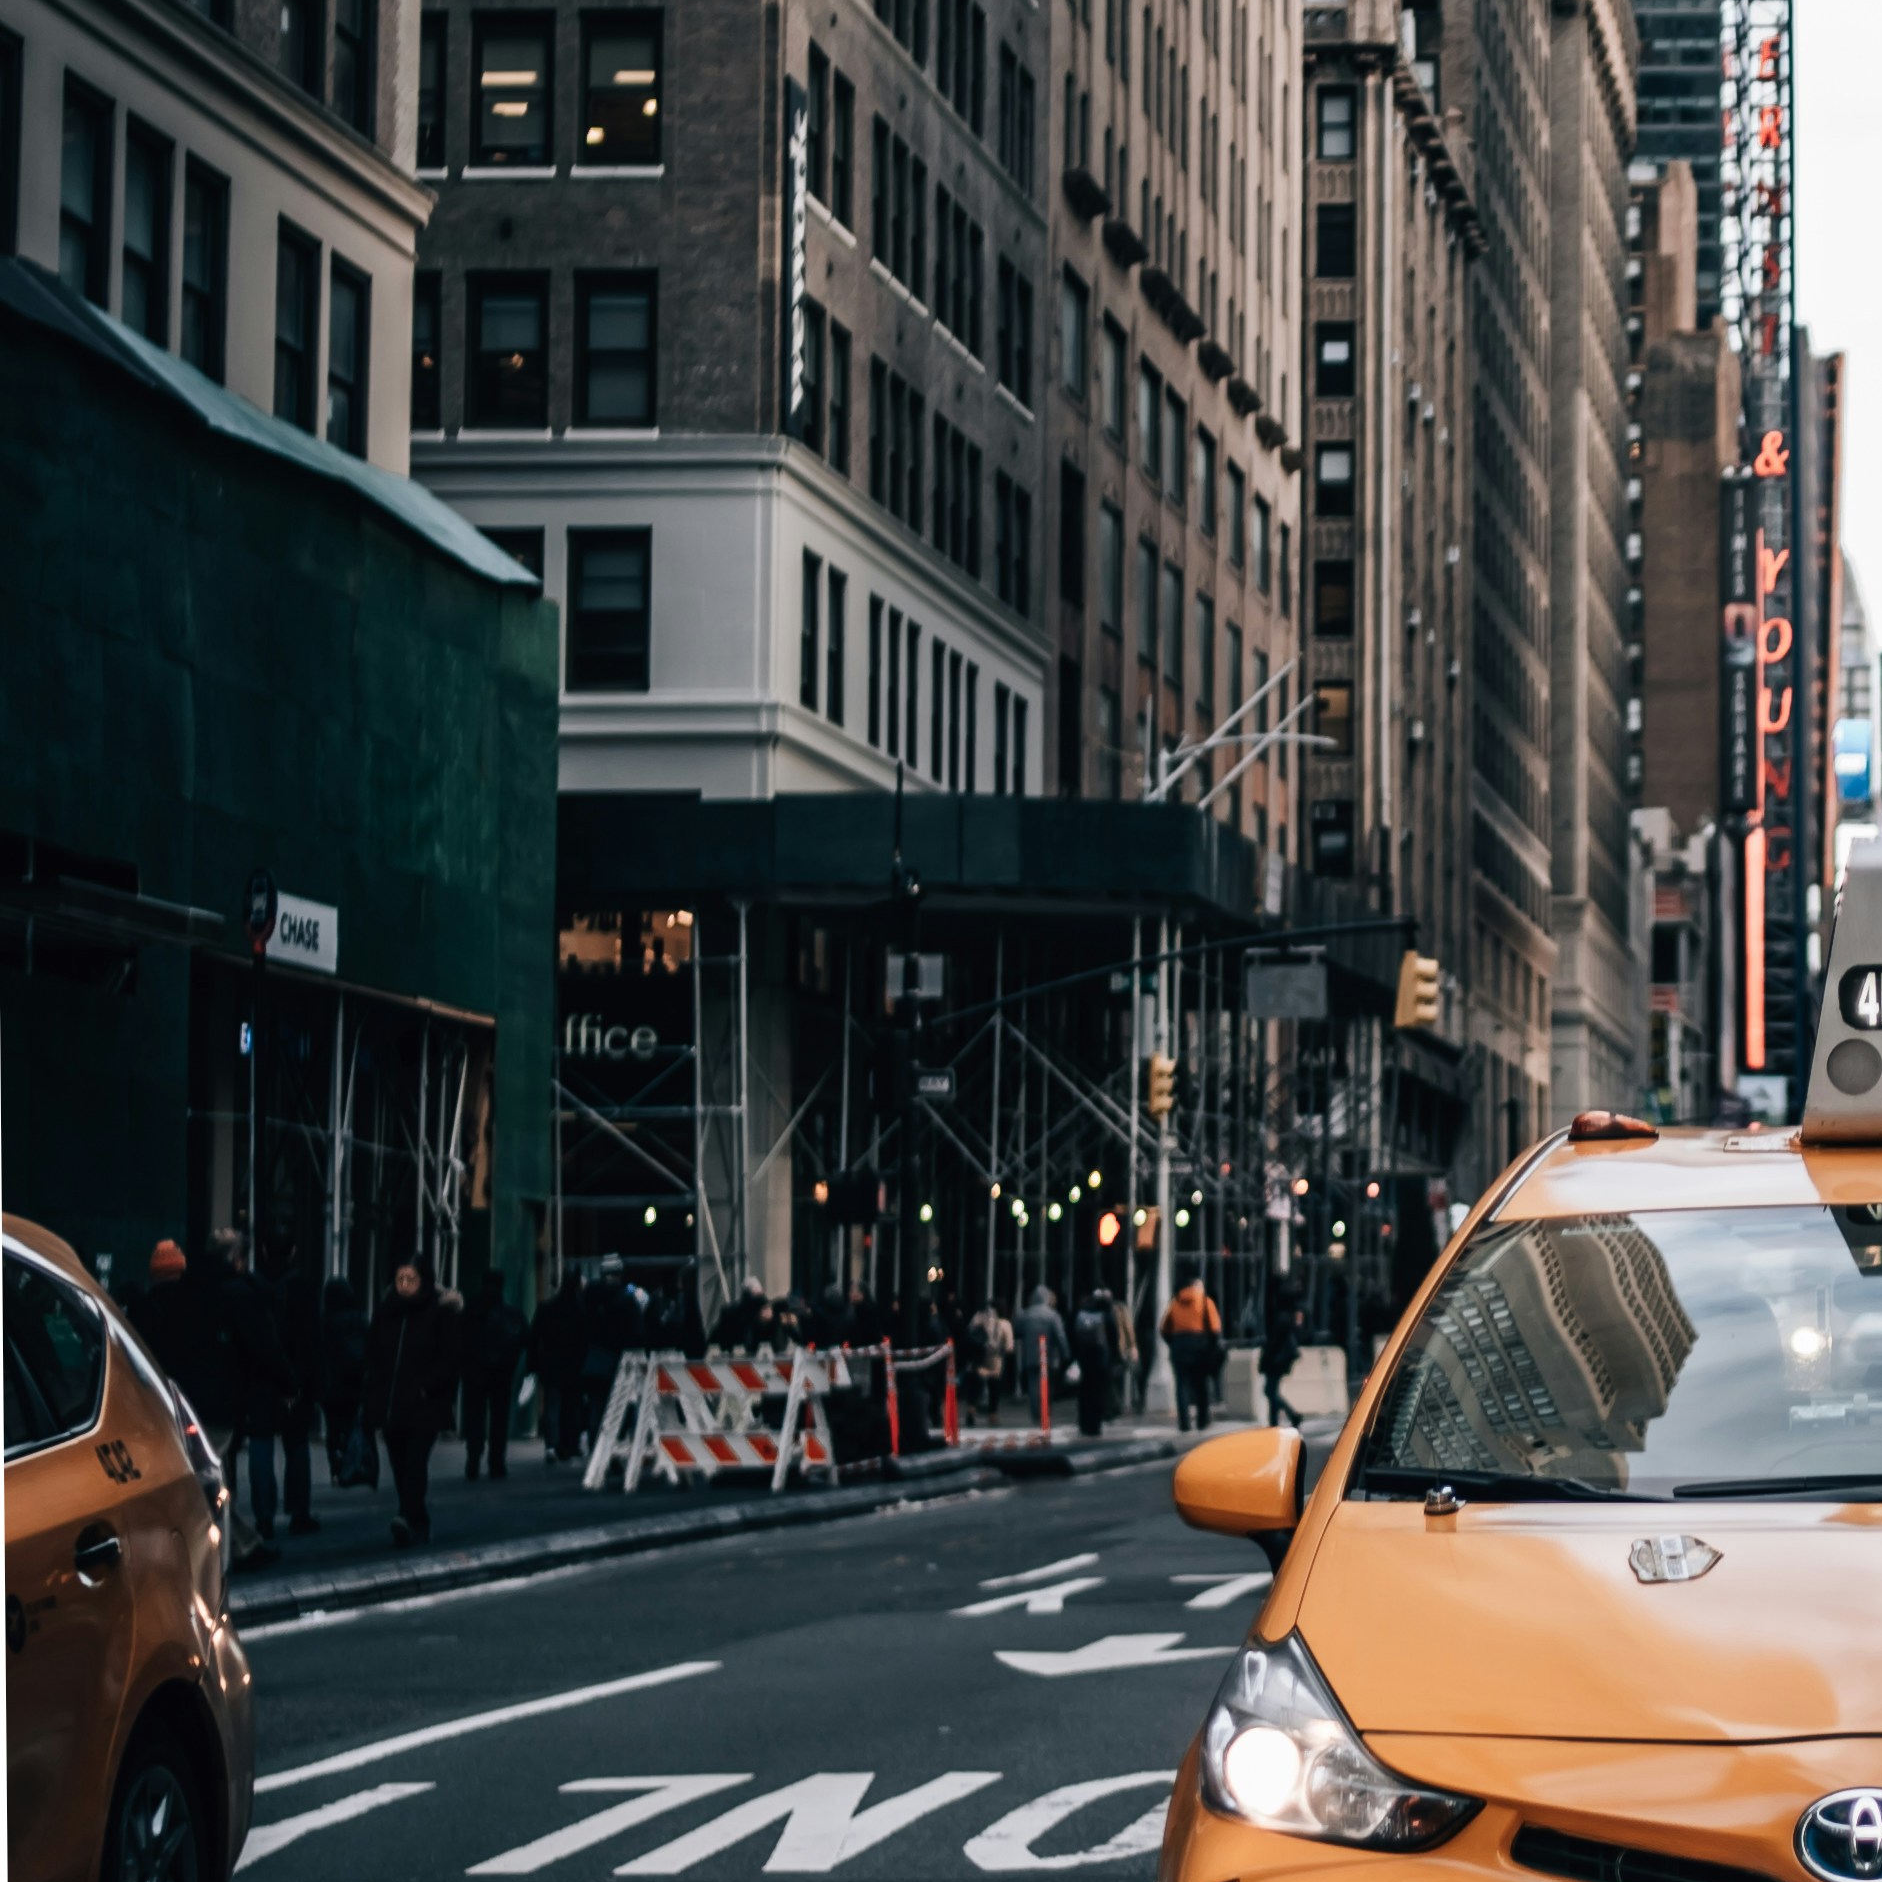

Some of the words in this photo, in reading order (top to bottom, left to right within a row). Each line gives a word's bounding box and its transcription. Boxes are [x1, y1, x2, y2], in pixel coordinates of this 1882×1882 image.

[1754, 428, 1790, 477] &
[1760, 547, 1793, 871] YOUNG
[280, 912, 320, 953] CHASE
[565, 1013, 658, 1059] ffice
